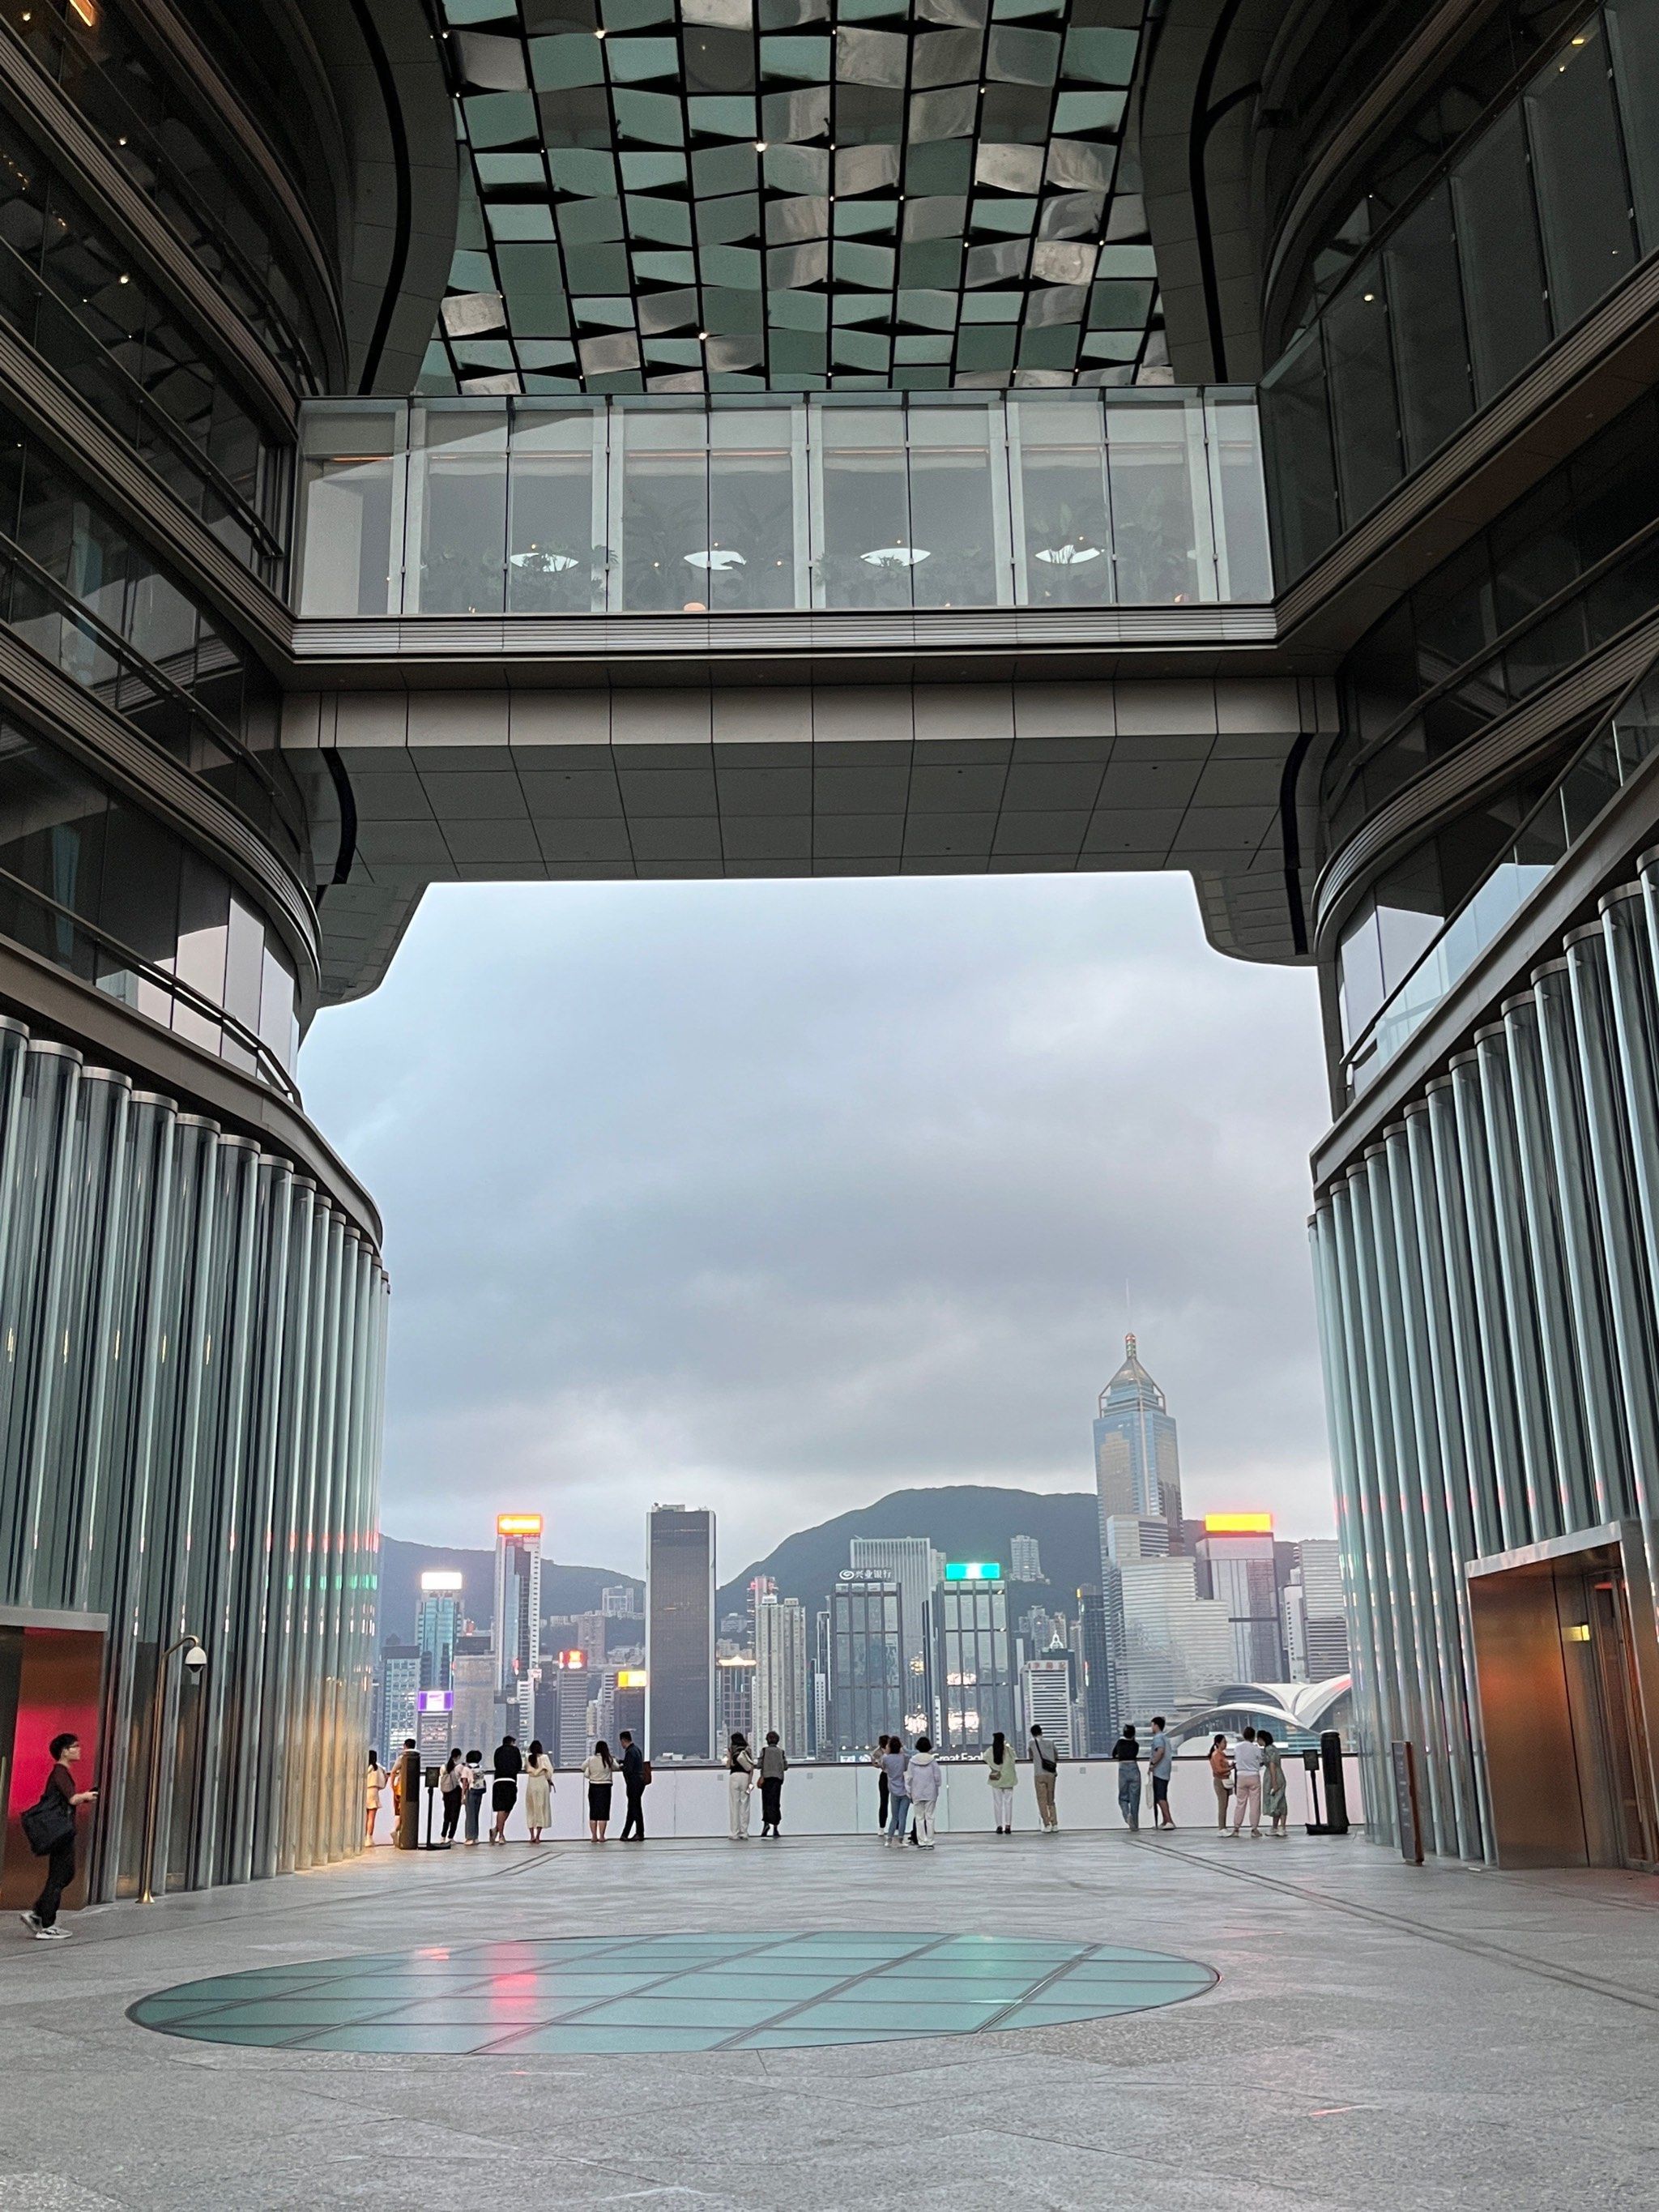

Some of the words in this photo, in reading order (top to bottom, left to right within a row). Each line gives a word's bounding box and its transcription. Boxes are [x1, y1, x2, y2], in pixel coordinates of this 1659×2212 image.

[855, 1569, 892, 1579] 兴业银行
[932, 1753, 961, 1761] Great
[961, 1751, 984, 1761] Eagl
